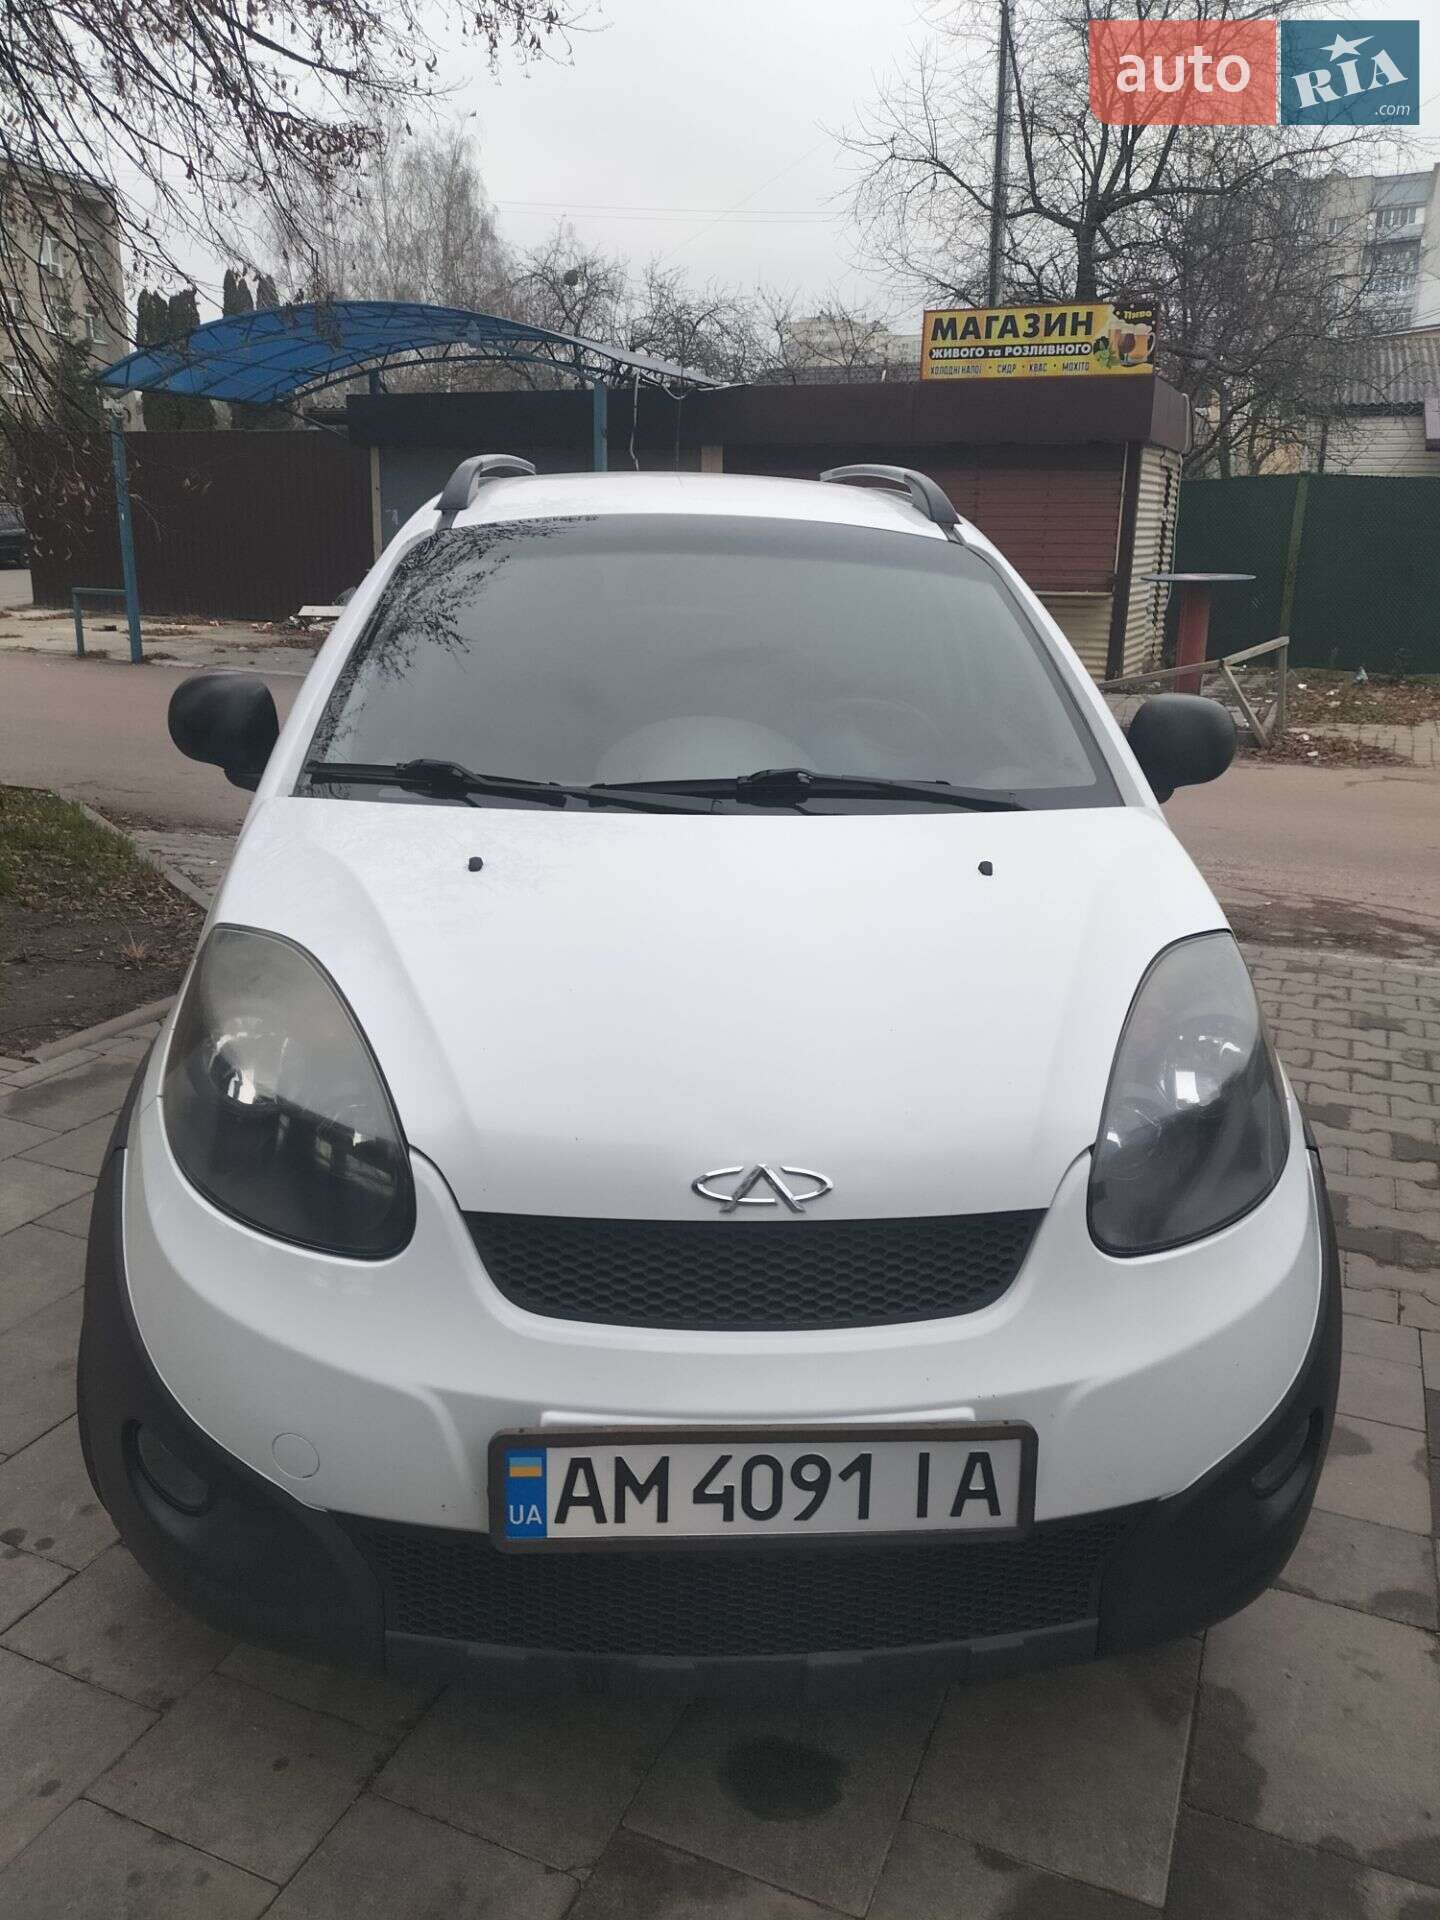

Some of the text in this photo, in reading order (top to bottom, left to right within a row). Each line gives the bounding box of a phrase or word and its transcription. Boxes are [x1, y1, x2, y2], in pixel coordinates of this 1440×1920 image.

[931, 311, 1094, 341] МАГАЗИН
[932, 343, 1092, 359] ЖИВОГО та РОЗЛИВНОГО
[554, 1451, 1001, 1524] AM 4091 IA
[509, 1504, 543, 1525] UA
